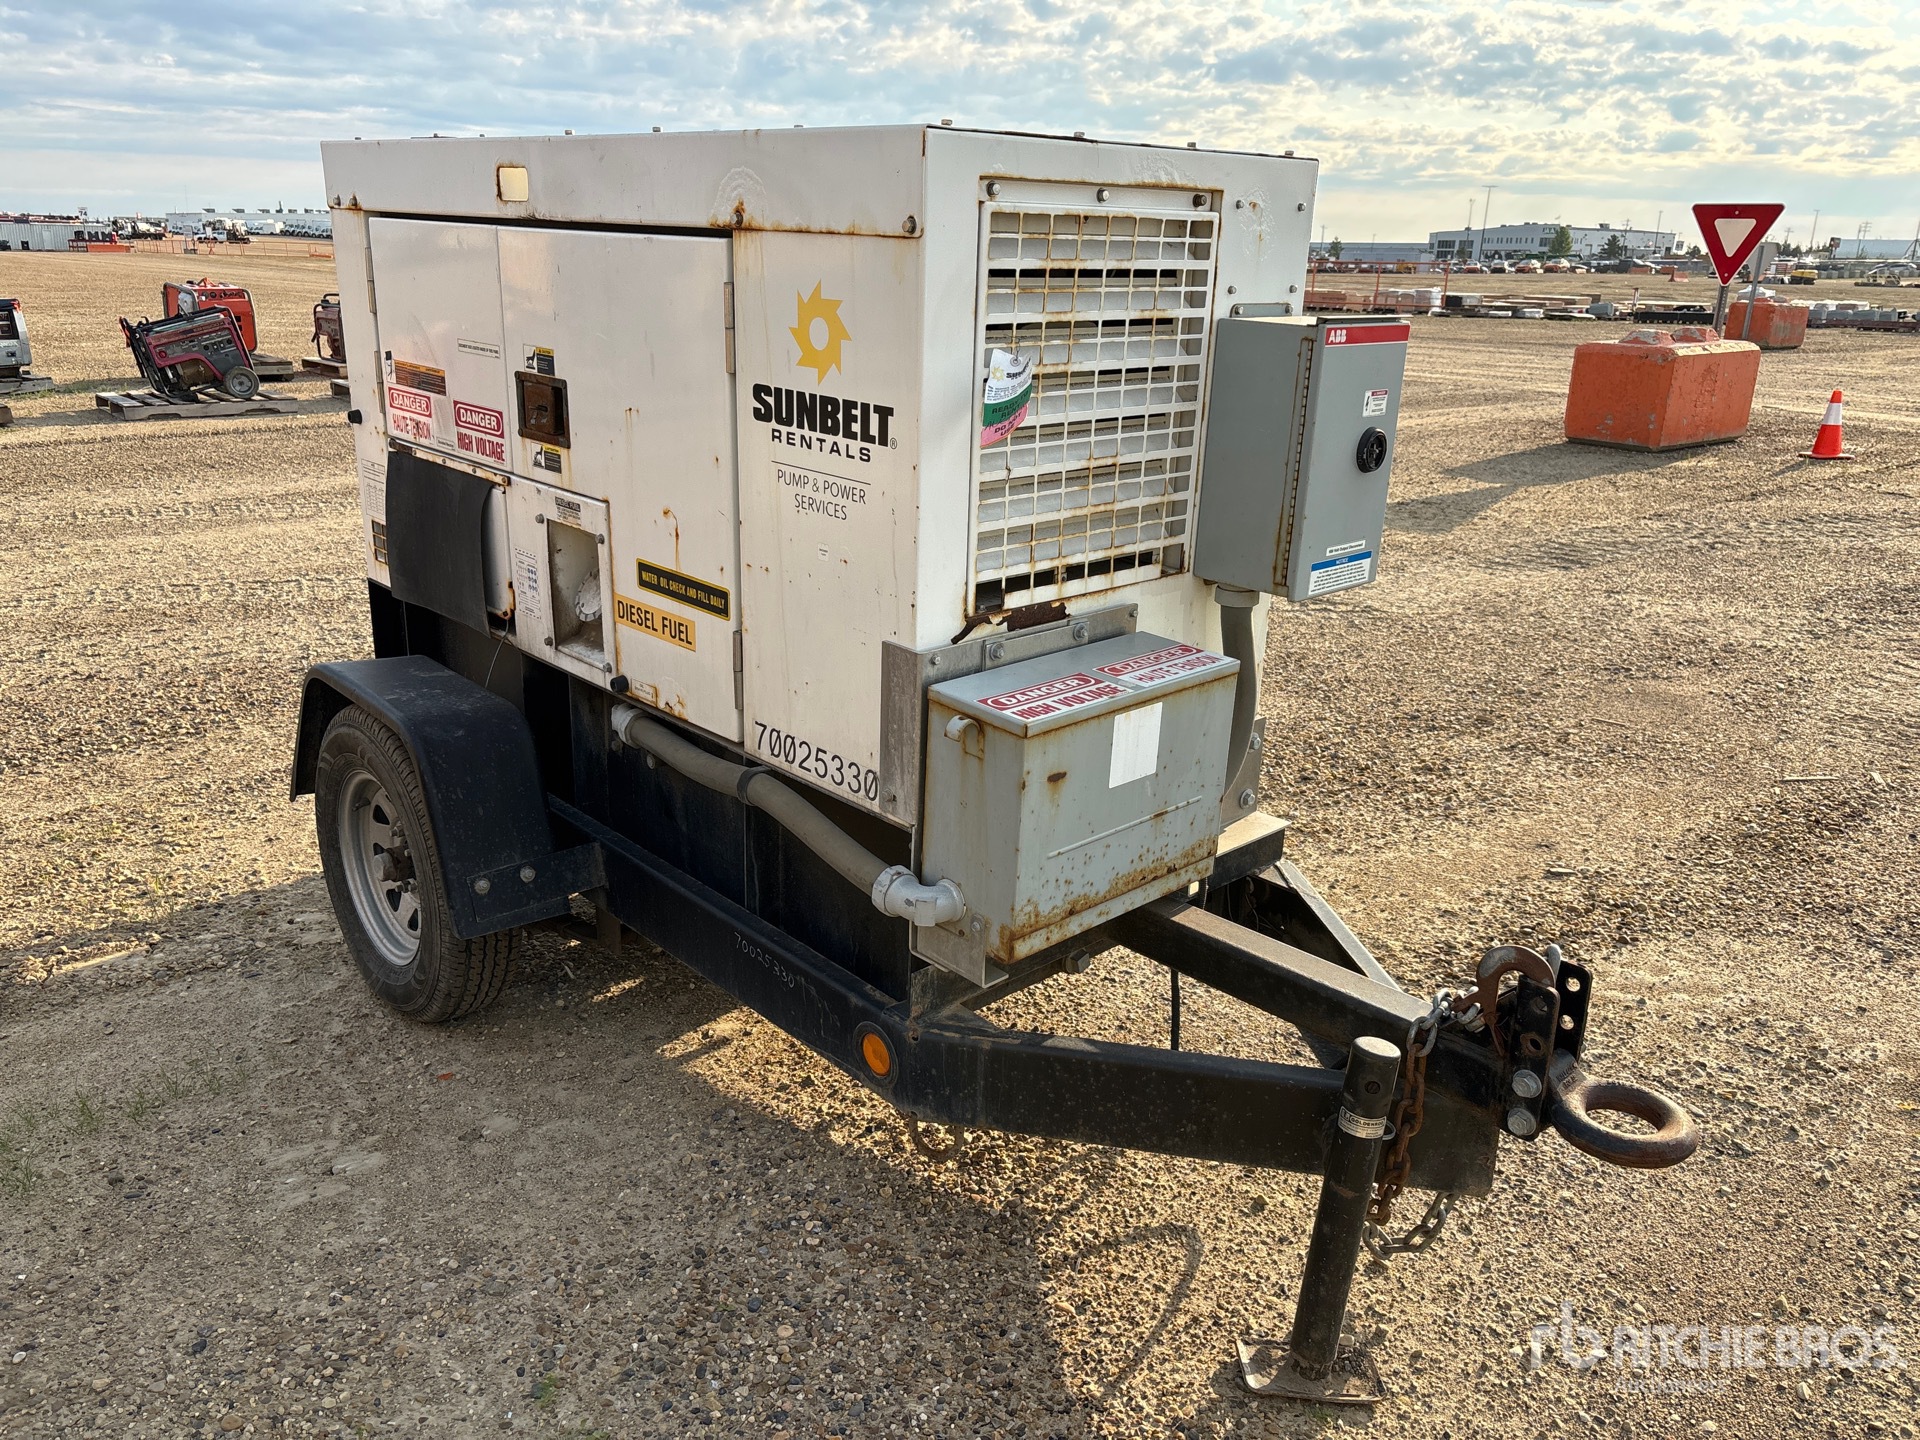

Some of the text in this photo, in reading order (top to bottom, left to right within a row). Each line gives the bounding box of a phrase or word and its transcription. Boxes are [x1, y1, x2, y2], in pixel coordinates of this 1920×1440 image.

[1328, 329, 1347, 343] ABB
[393, 392, 427, 412] DANGER
[752, 383, 894, 447] SUNBELT
[460, 408, 498, 430] DANGER
[994, 424, 1006, 433] DO
[457, 430, 505, 461] HIGH VOLTAGE
[771, 428, 871, 463] RENTALS
[777, 468, 866, 504] PUMP & POWER
[794, 493, 847, 521] SERVICES
[641, 570, 725, 609] WATER OIL CHECK AND FILL DAILY
[617, 600, 692, 645] DIESEL FUEL
[1115, 647, 1185, 671] DANGER
[1129, 654, 1225, 683] HAUTE TENSION
[999, 679, 1083, 706] DANGER
[1011, 684, 1127, 720] HIGH VOLTAGE
[755, 721, 878, 801] 70025330
[734, 931, 795, 988] 70025330
